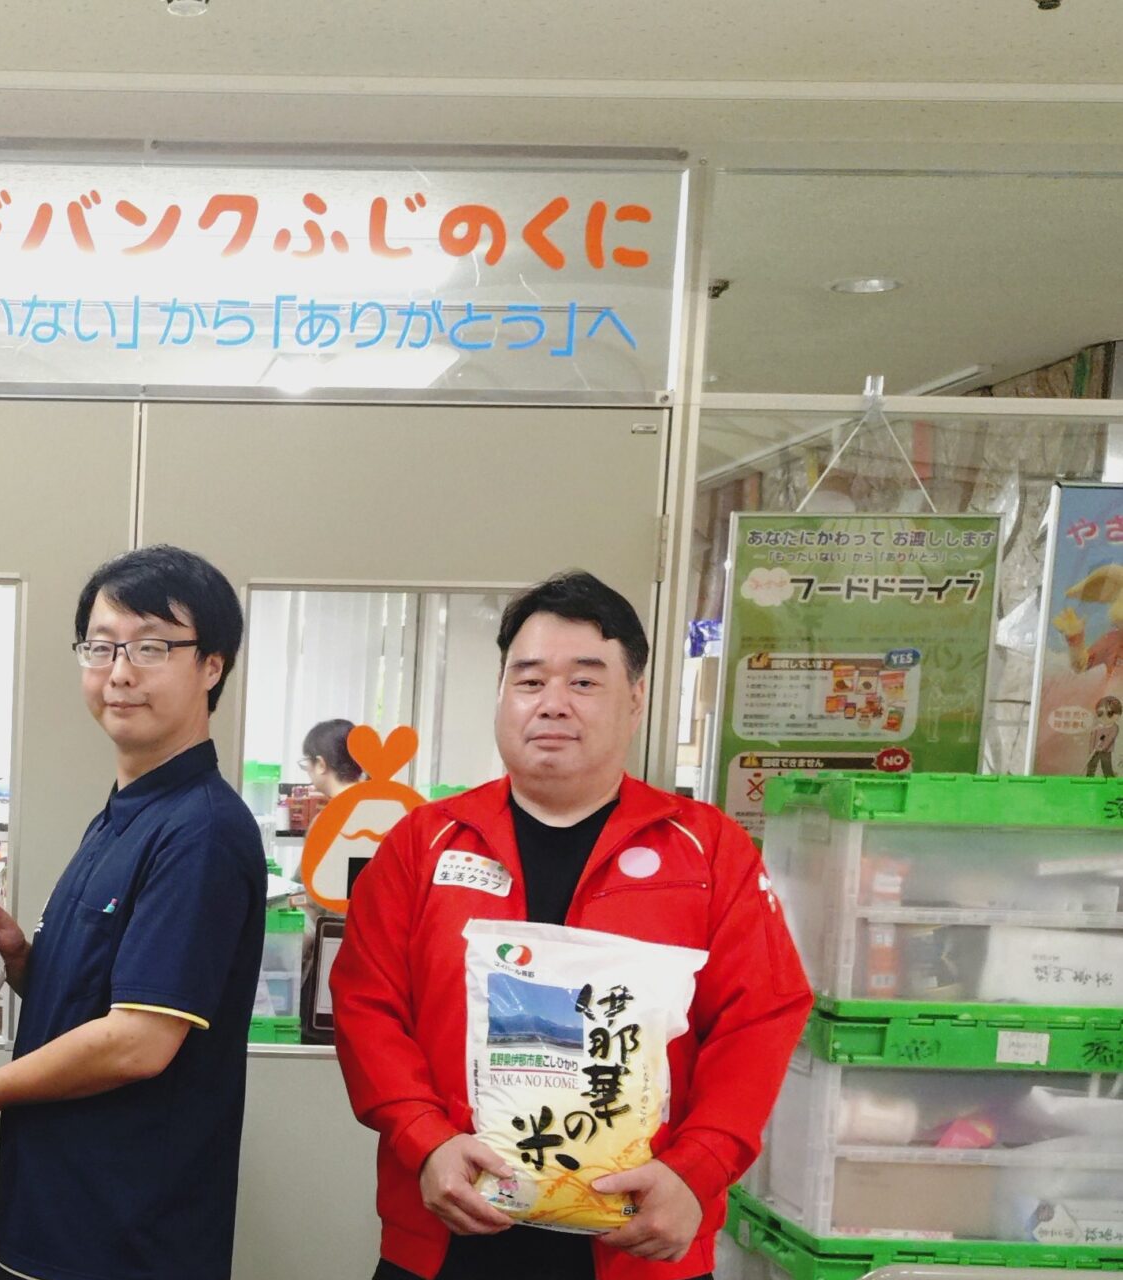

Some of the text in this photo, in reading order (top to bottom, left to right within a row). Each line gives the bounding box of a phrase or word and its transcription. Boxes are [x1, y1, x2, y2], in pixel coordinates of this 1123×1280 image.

[747, 530, 995, 547] あなたにかわって お渡しします
[789, 572, 982, 600] フードドライブ
[770, 659, 834, 669] 回収しています
[890, 653, 914, 664] YES
[762, 757, 824, 768] 回収できません
[883, 754, 904, 766] NO
[439, 870, 507, 890] 生活クラブ
[489, 1052, 579, 1071] 長野県伊那市産こしひかり
[512, 983, 641, 1171] 伊那華の米
[525, 1074, 542, 1087] NO
[544, 1074, 579, 1089] KOME
